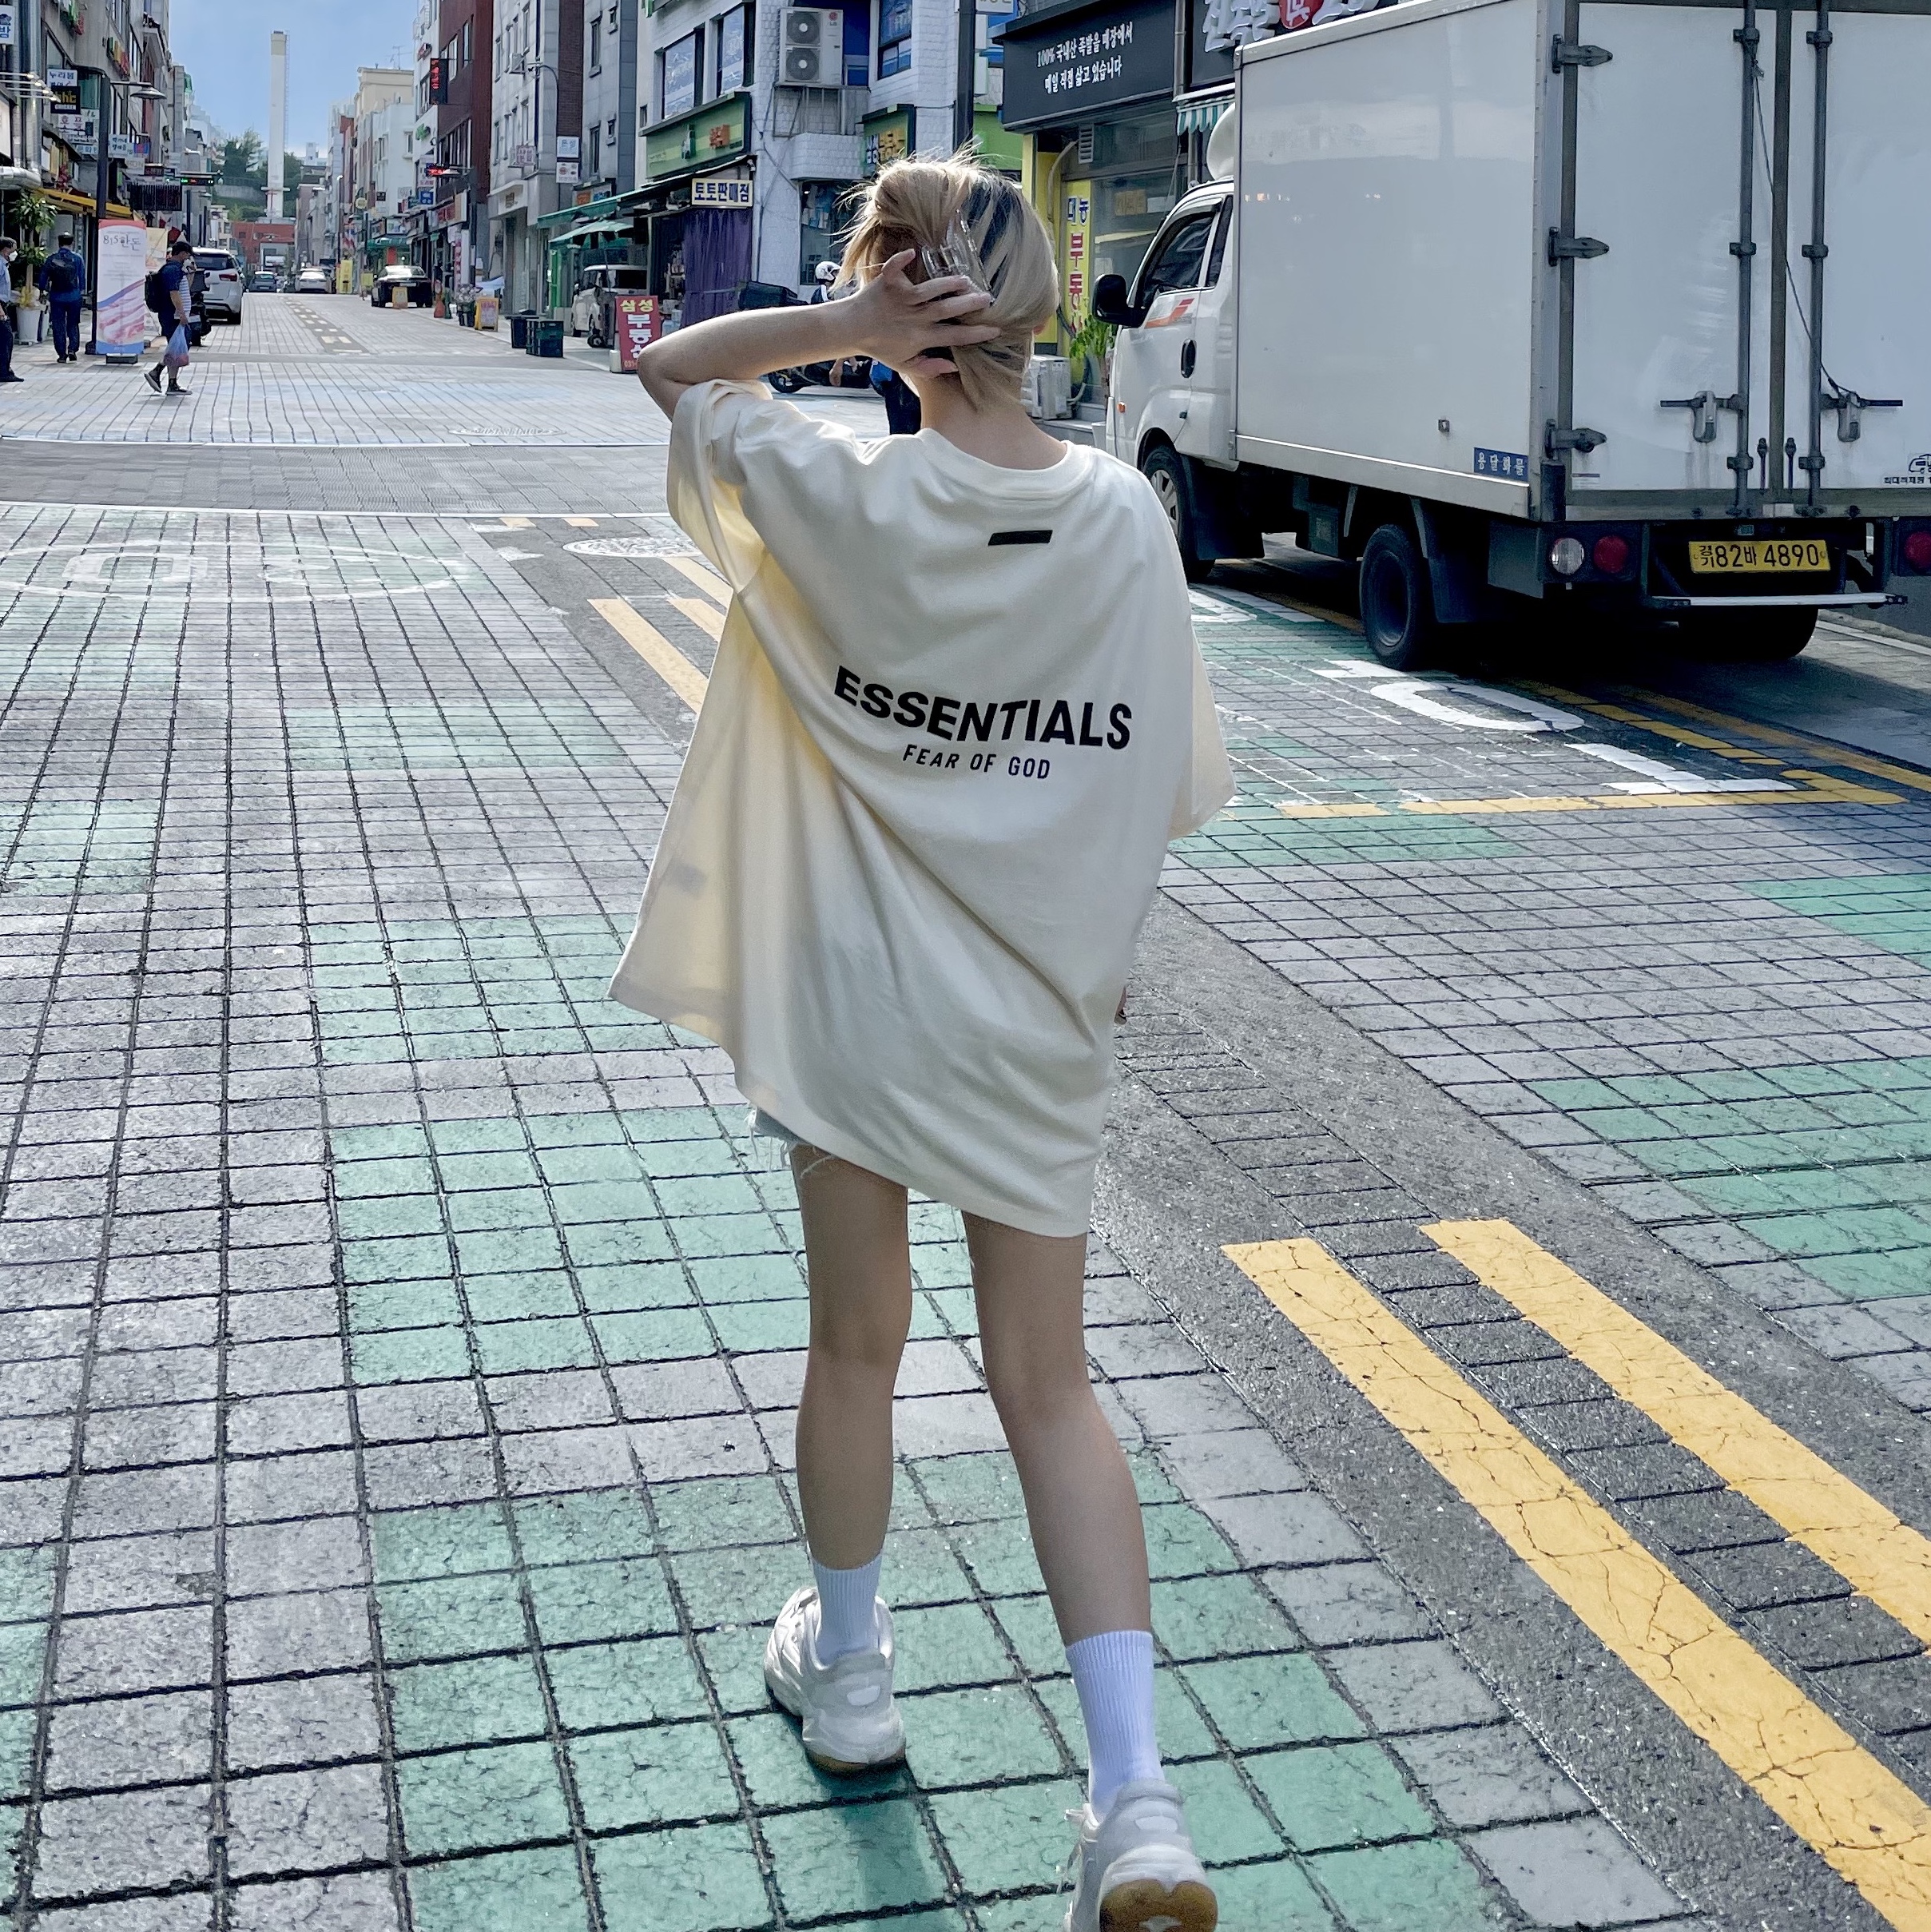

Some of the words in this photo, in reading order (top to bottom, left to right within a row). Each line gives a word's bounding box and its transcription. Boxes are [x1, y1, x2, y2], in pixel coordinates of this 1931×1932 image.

[1056, 38, 1077, 63] 국내산
[1079, 32, 1101, 57] 족발을
[1102, 22, 1133, 50] 매장에서
[1044, 72, 1059, 93] 매일
[1059, 67, 1074, 90] 직접
[1075, 65, 1091, 87] 삶고
[1091, 55, 1122, 83] 있습니다
[1478, 451, 1525, 475] 용달화물
[1699, 545, 1715, 568] 경기
[1764, 544, 1819, 566] 4890
[834, 666, 1132, 749] ESSENTIALS
[903, 744, 960, 769] FEAR
[969, 753, 997, 773] OF
[1007, 756, 1051, 780] GOD
